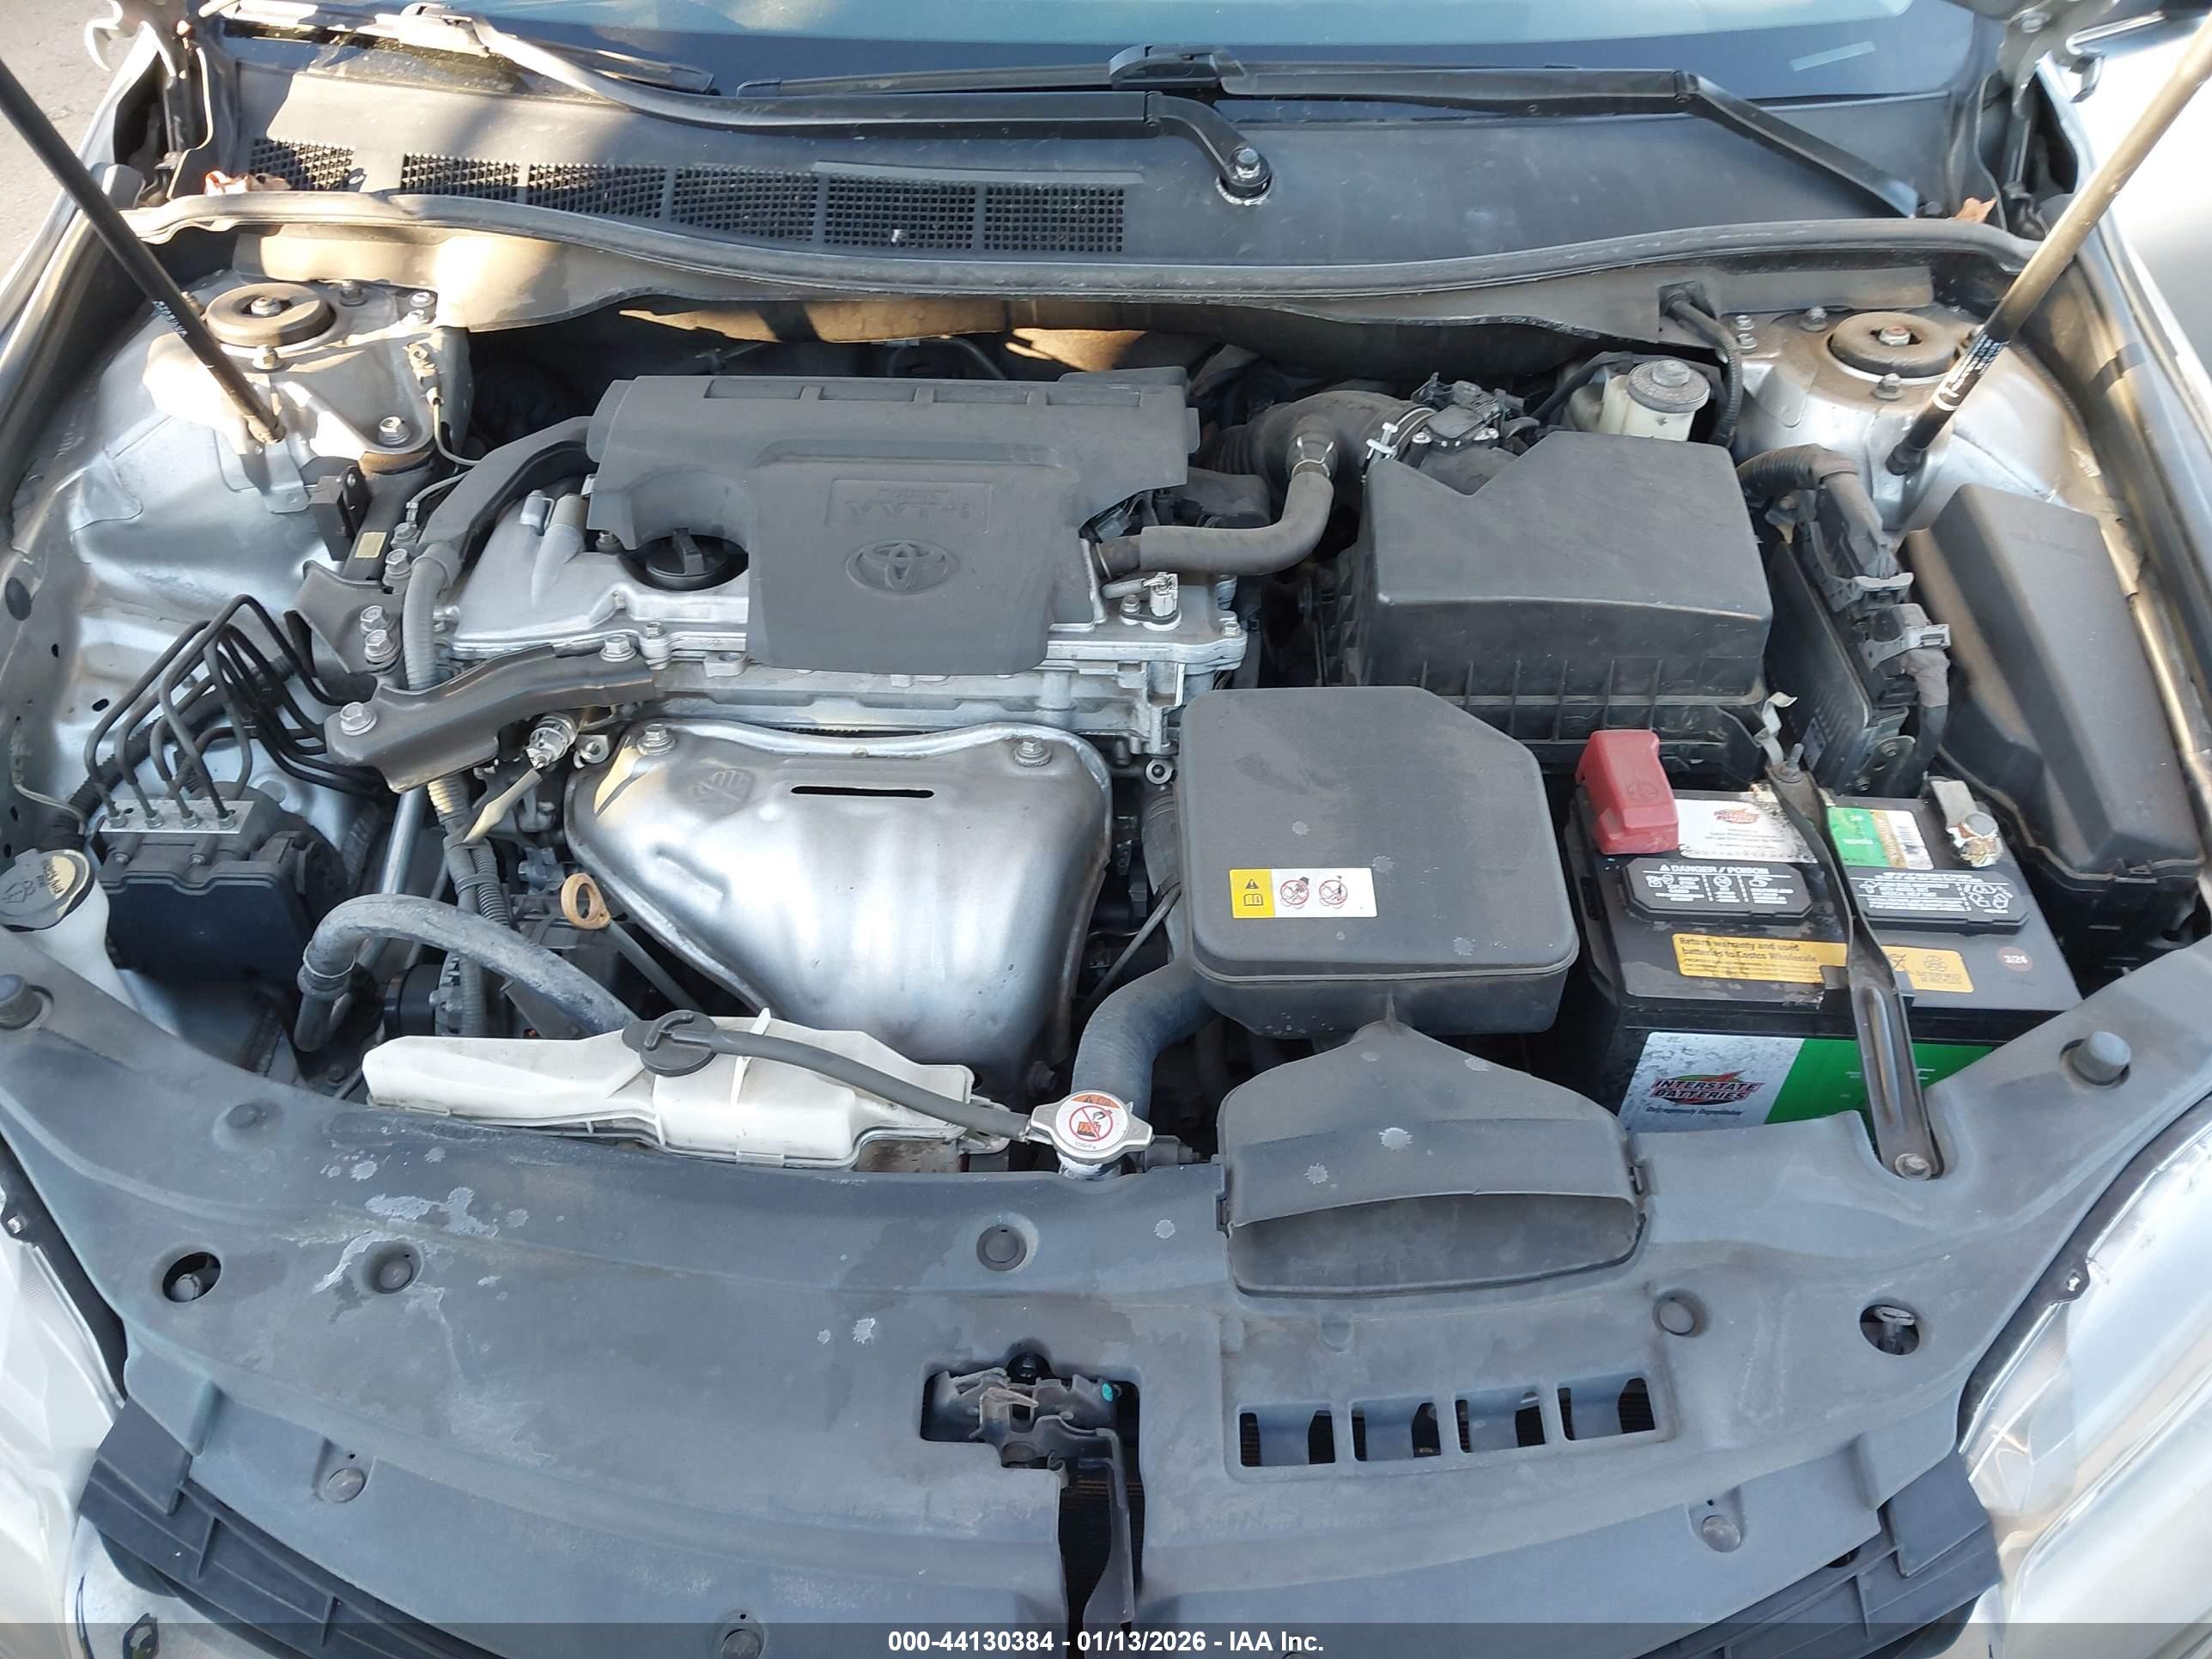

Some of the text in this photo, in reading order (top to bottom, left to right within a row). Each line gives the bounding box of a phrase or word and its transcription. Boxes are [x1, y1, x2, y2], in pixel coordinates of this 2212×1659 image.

[1670, 865, 1717, 873] DANGER
[1727, 866, 1770, 875] POISON
[1757, 941, 1776, 951] and
[1777, 942, 1800, 952] used
[1655, 1079, 1758, 1091] INTERSTATE
[1654, 1088, 1747, 1100] BATTERIES
